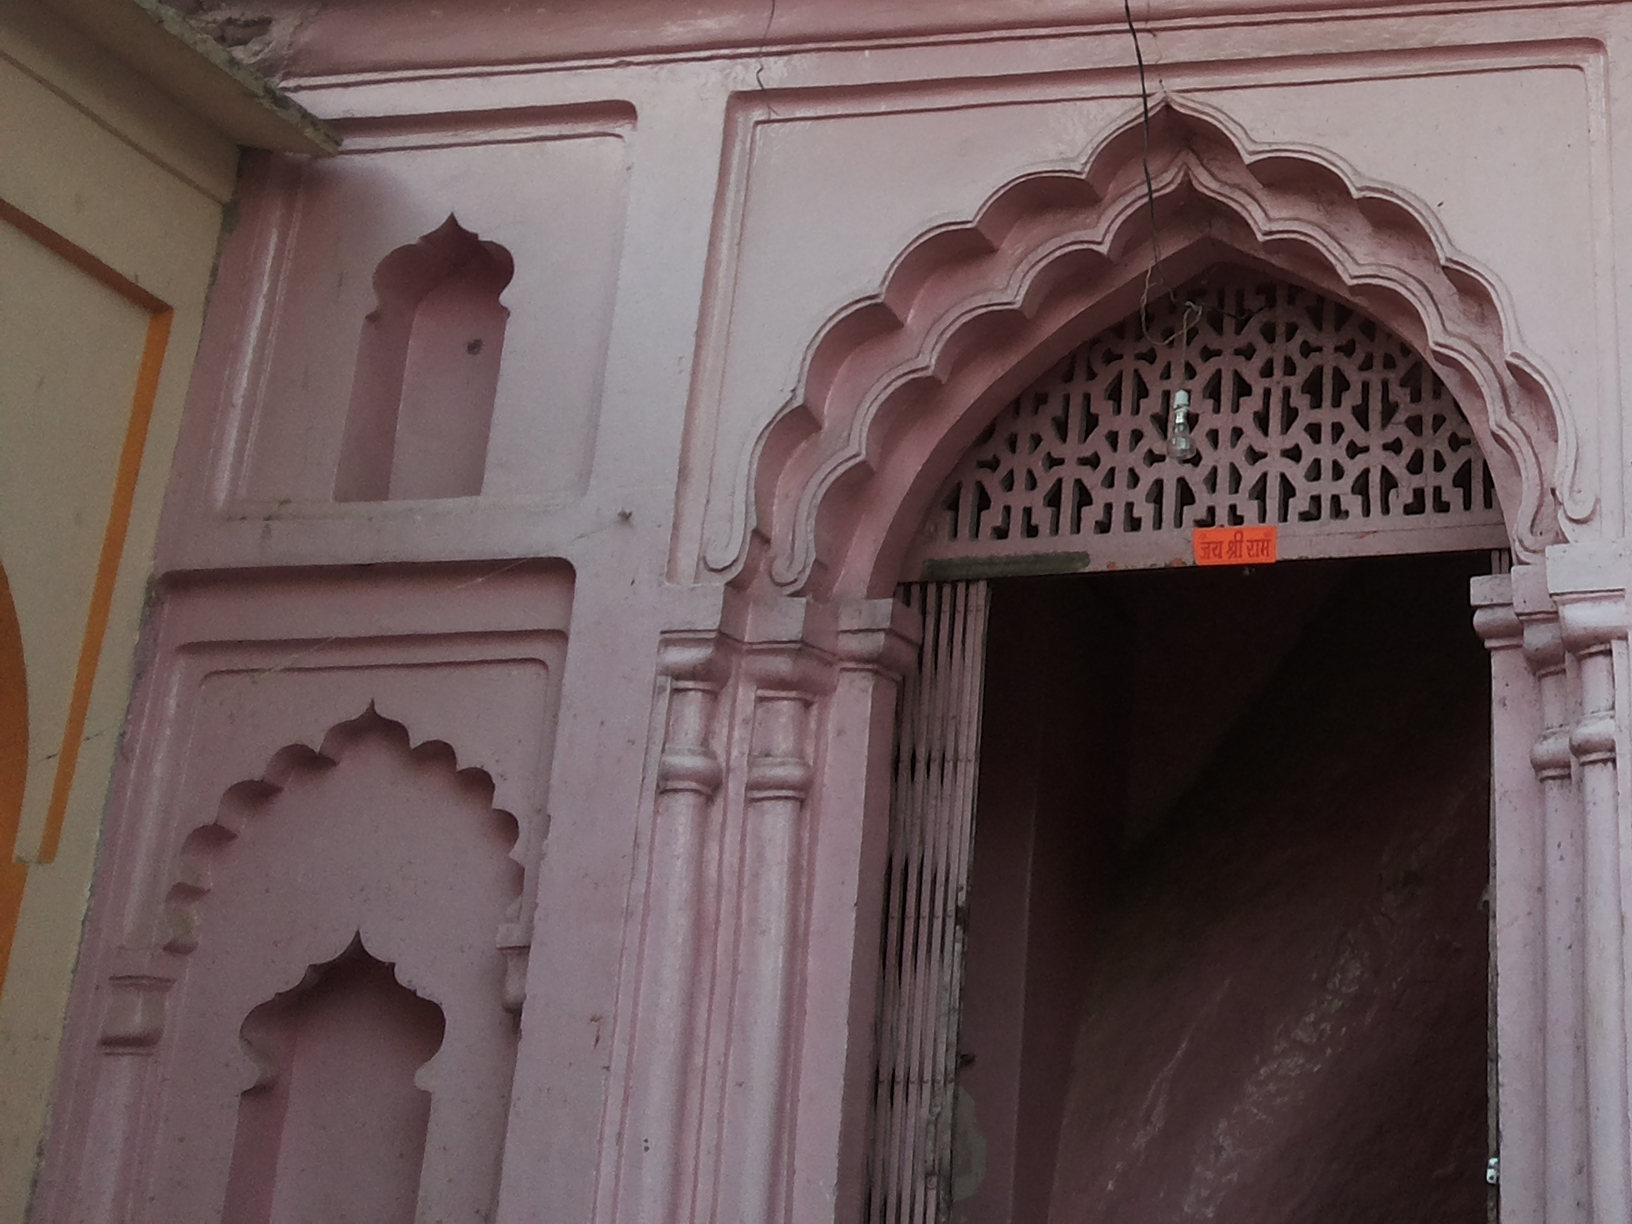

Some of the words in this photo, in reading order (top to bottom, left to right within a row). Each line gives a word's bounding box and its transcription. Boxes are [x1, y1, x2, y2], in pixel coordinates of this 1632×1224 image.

[1200, 539, 1224, 560] जय
[1225, 530, 1245, 561] श्री
[1246, 537, 1273, 559] राम
